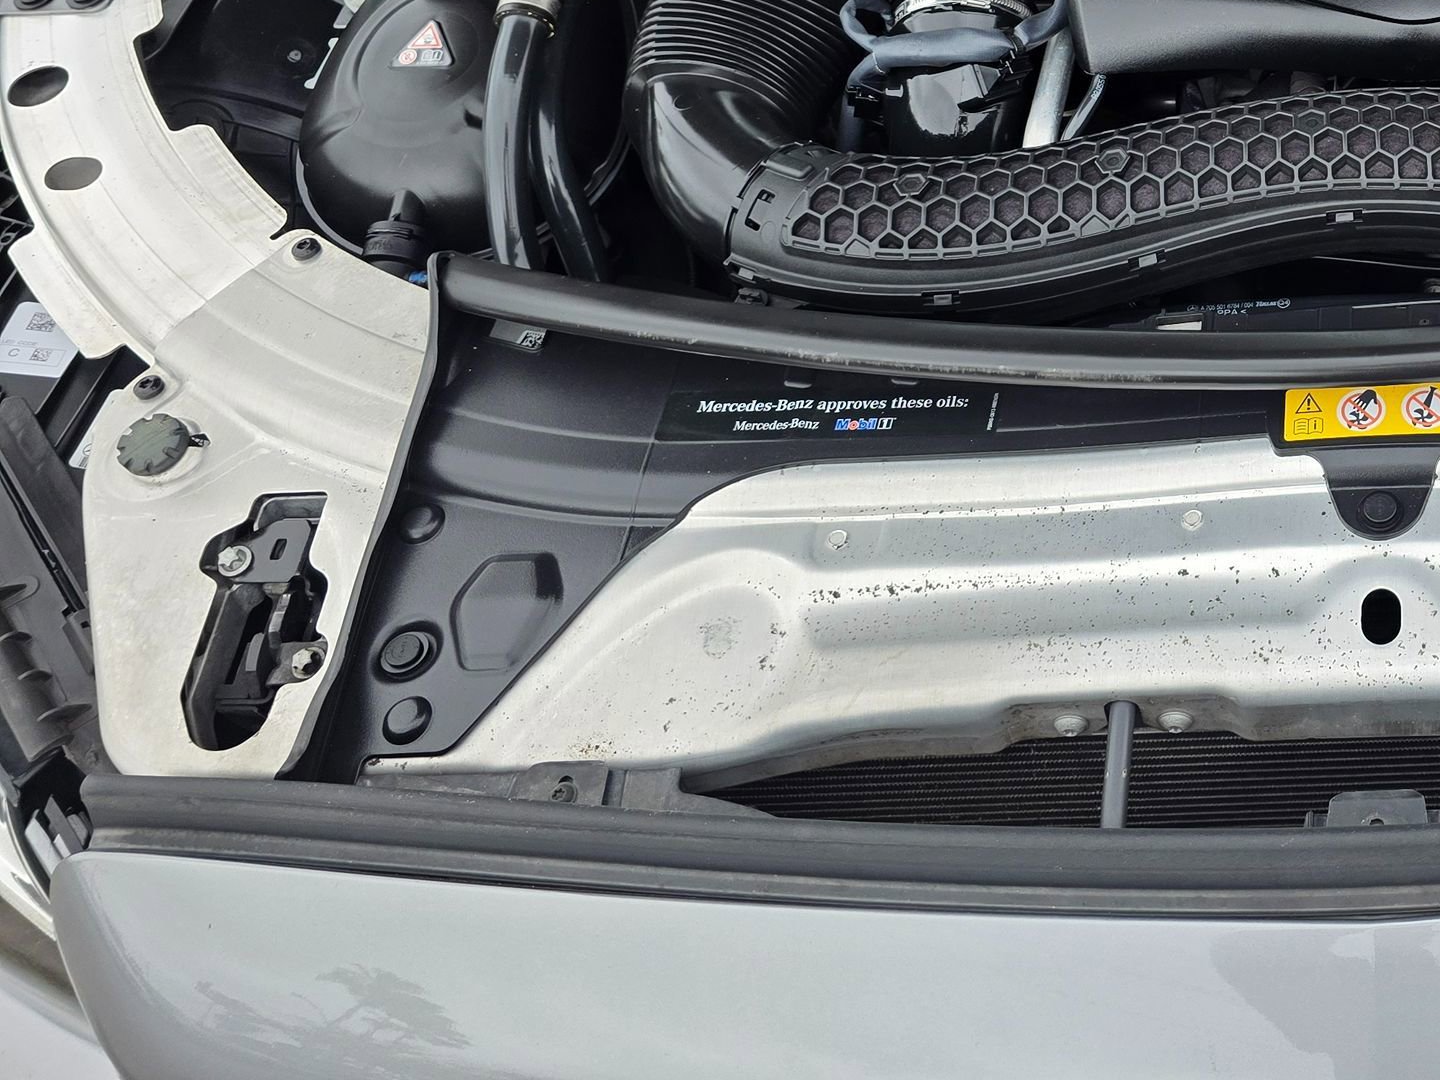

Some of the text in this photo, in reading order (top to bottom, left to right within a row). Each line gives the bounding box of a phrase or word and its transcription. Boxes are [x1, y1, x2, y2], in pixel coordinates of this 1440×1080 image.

[697, 394, 969, 414] Mercedes-Benz approves these oils:
[733, 418, 820, 431] Mercedes-Benz
[834, 417, 876, 431] Mobil
